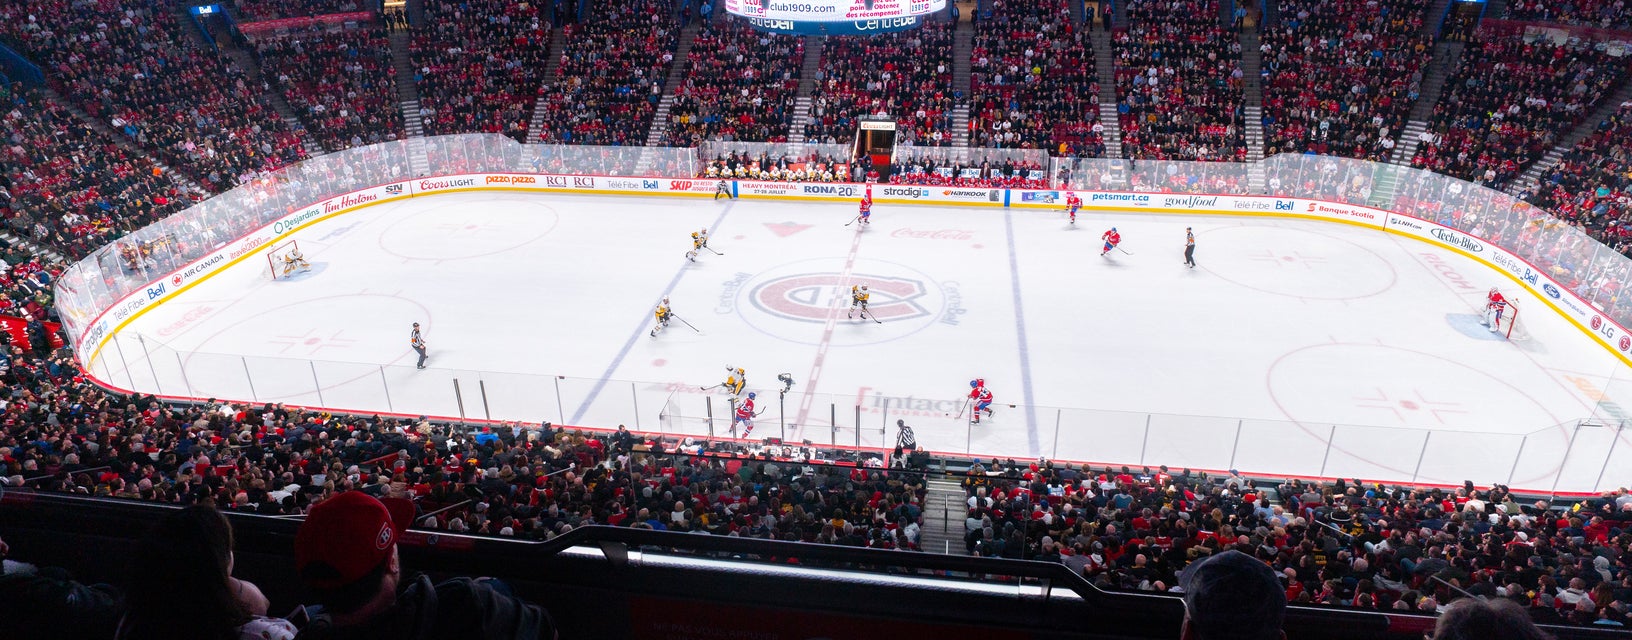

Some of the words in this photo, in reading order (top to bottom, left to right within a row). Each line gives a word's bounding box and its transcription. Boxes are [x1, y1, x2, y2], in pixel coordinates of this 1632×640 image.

[770, 3, 836, 13] club1909.com
[420, 179, 450, 191] Coors
[450, 178, 475, 187] LIGHT
[485, 175, 511, 185] pizza
[511, 175, 536, 186] pizza
[546, 176, 567, 186] RCI
[574, 177, 595, 187] RCI
[608, 180, 623, 189] Télé
[623, 180, 639, 190] Fibe
[643, 180, 659, 190] Bell
[669, 180, 693, 191] SKIP
[385, 183, 403, 193] SN
[763, 182, 797, 191] MONTRÉAL
[803, 185, 838, 194] RONA
[883, 187, 922, 198] stradigi
[1092, 193, 1150, 202] petsmart.ca
[322, 200, 340, 214] Tim
[341, 193, 378, 209] Hortons
[1164, 196, 1218, 208] goodfood
[1233, 200, 1251, 209] Télé
[1251, 200, 1270, 210] Fibe
[1275, 200, 1295, 211] Bell
[1318, 205, 1350, 216] Banque
[1350, 209, 1375, 220] Scotia
[283, 208, 320, 229] Desjardins
[183, 268, 196, 279] AIR
[195, 253, 225, 273] CANADA
[1506, 259, 1522, 275] Fibe
[1523, 268, 1539, 287] Bell
[127, 298, 145, 312] Fibe
[147, 282, 166, 300] Bell
[1601, 323, 1616, 340] LG
